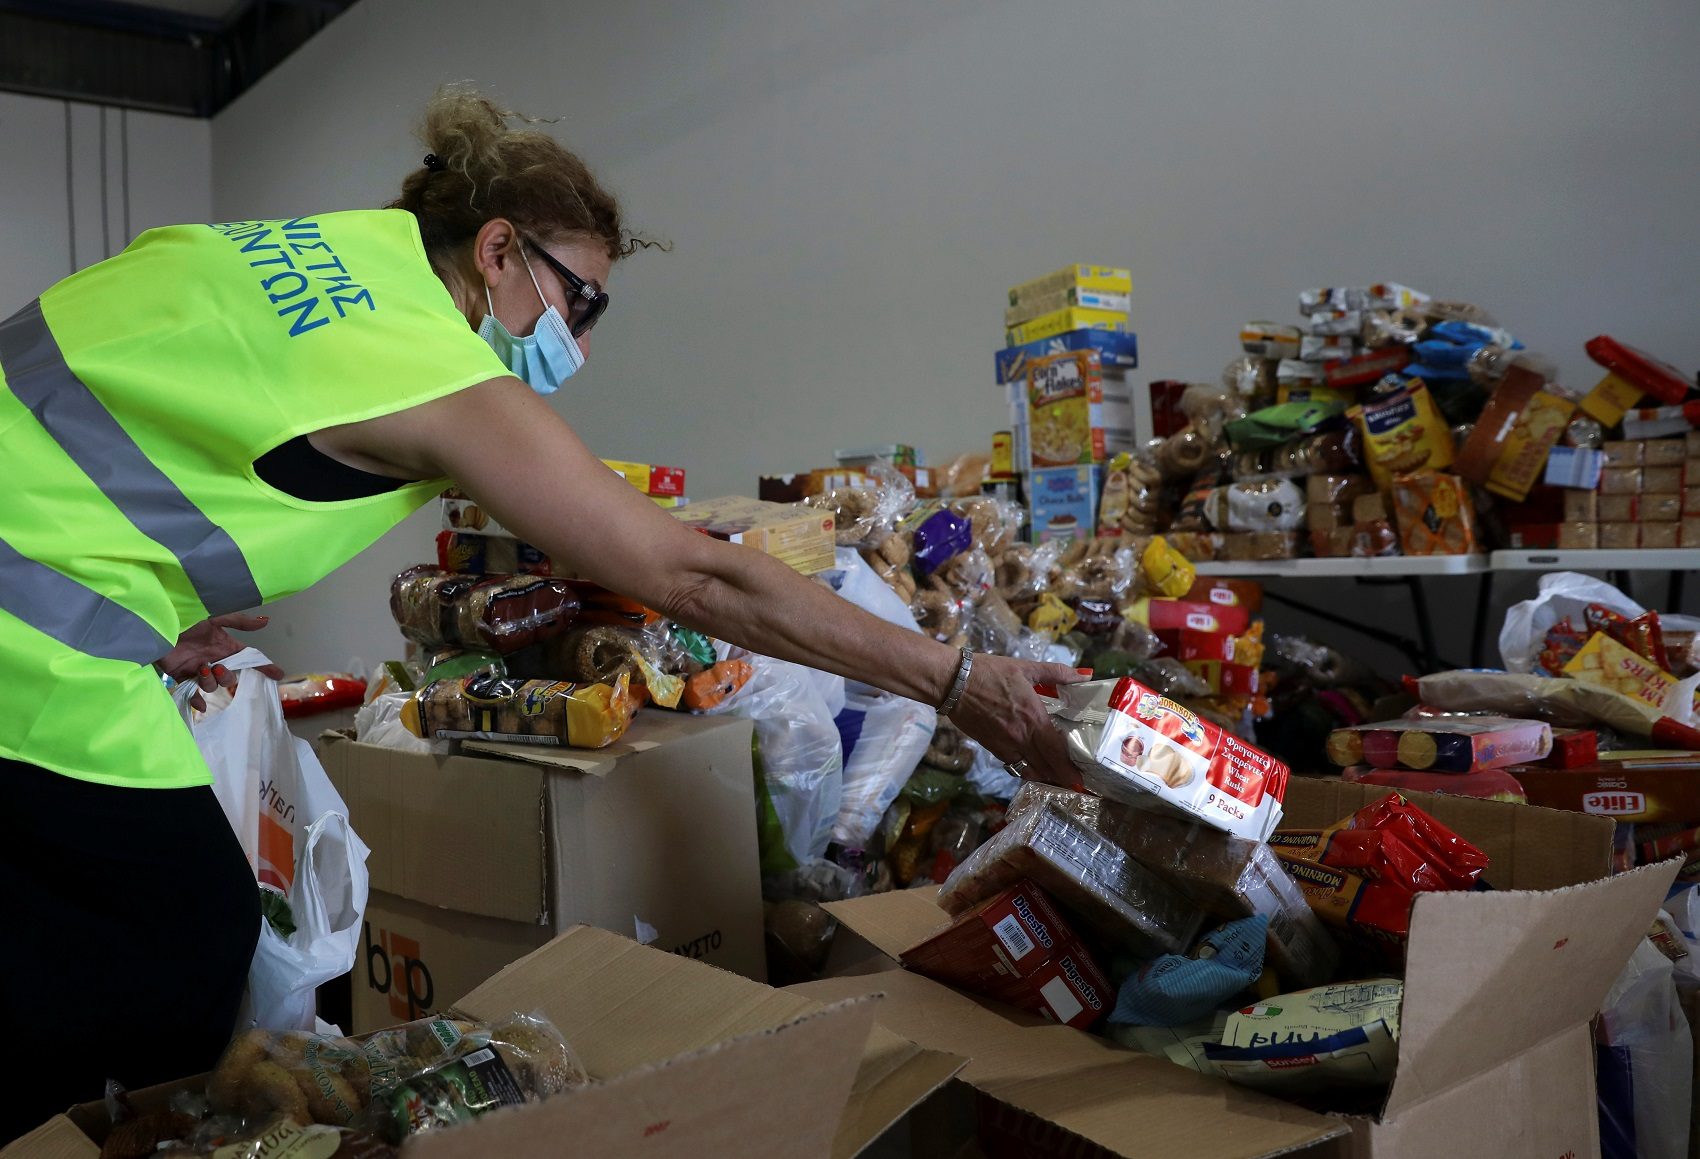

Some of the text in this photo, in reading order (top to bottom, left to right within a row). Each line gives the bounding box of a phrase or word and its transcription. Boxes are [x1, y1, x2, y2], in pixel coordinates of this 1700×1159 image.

[207, 221, 331, 338] ΟΝΤΩΝ
[1158, 696, 1195, 723] JOHNSOF
[1221, 747, 1265, 779] Σιταρένιες
[1226, 737, 1271, 771] Φρυγανιές
[1223, 776, 1246, 794] Rusks
[1228, 765, 1250, 784] Wheat
[1207, 793, 1216, 804] 9
[1216, 798, 1246, 820] Packs
[1588, 795, 1640, 812] Elite
[1283, 834, 1320, 845] MORNING
[1291, 864, 1342, 888] MORNING
[1012, 894, 1054, 949] Digestive
[1059, 955, 1102, 1010] Digestive
